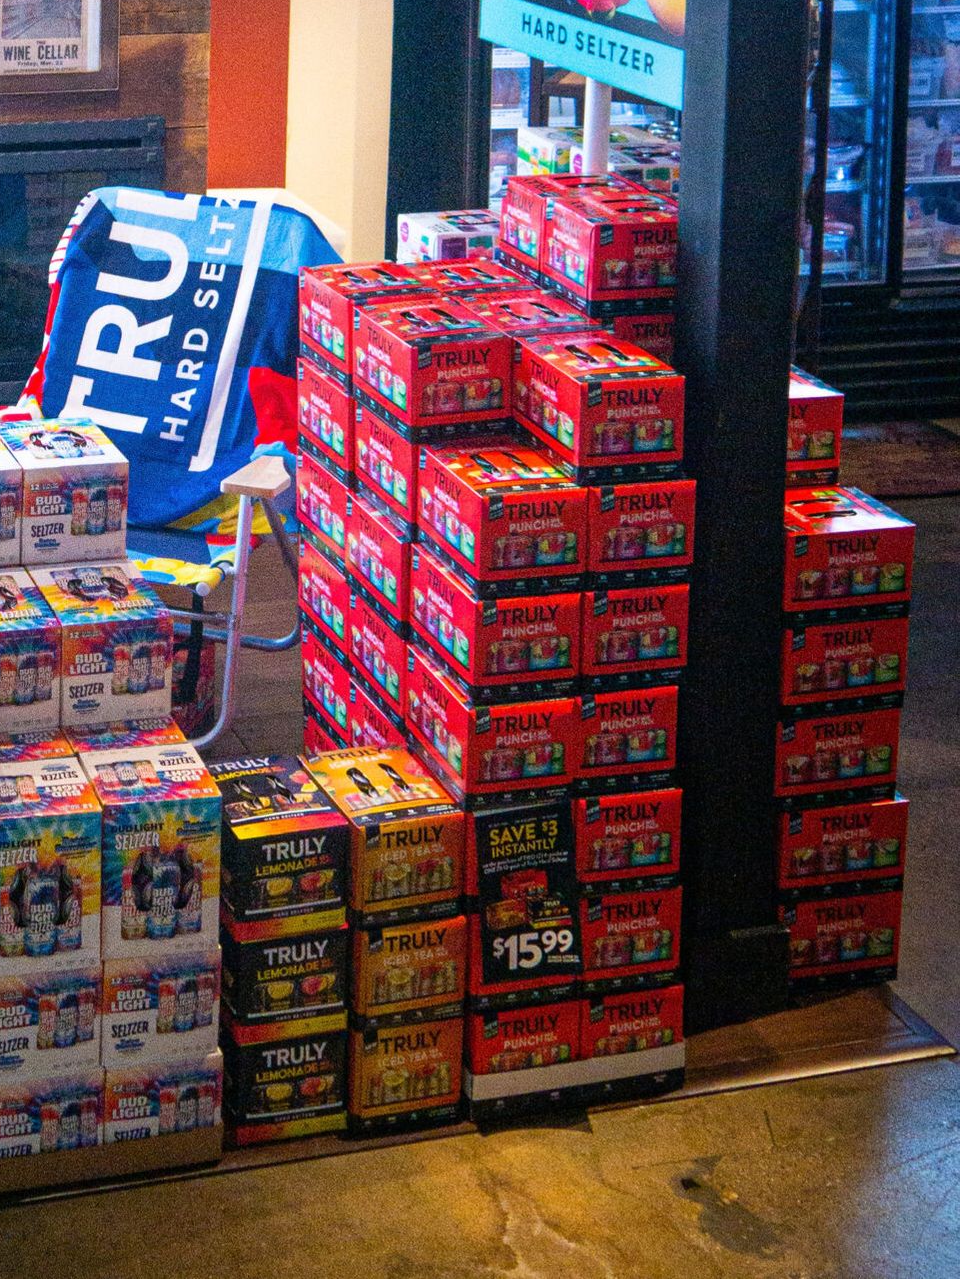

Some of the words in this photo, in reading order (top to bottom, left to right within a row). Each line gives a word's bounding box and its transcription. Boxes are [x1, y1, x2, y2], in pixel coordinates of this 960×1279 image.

[3, 46, 31, 61] WINE
[38, 44, 79, 60] CELLAR
[521, 11, 569, 47] HARD
[575, 31, 655, 76] SELTZER
[431, 348, 491, 368] TRULY
[159, 327, 210, 442] HARD
[531, 360, 560, 390] TRULY
[603, 387, 664, 406] TRULY
[607, 405, 646, 418] PUNCH
[434, 468, 462, 499] TRULY
[30, 504, 66, 515] LIGHT
[36, 495, 61, 506] BUD
[506, 500, 567, 519] TRULY
[615, 491, 675, 511] TRULY
[508, 518, 549, 533] PUNCH
[619, 509, 658, 524] PUNCH
[31, 523, 64, 538] SELTZER
[826, 537, 880, 555] TRULY
[498, 605, 559, 624] TRULY
[607, 595, 668, 615] TRULY
[822, 629, 875, 647] TRULY
[70, 662, 107, 675] LIGHT
[75, 653, 104, 666] BUD
[69, 682, 105, 699] SELTZER
[595, 699, 655, 718] TRULY
[491, 712, 553, 733] TRULY
[496, 729, 536, 745] PUNCH
[210, 756, 270, 772] TRULY
[600, 801, 662, 823] TRULY
[114, 831, 161, 851] SELTZER
[384, 824, 445, 849] TRULY
[490, 823, 536, 846] SAVE
[542, 819, 558, 836] $3
[262, 836, 327, 861] TRULY
[492, 837, 556, 858] INSTANTLY
[255, 859, 317, 877] LEMONADE
[602, 899, 662, 921] TRULY
[264, 940, 328, 966] TRULY
